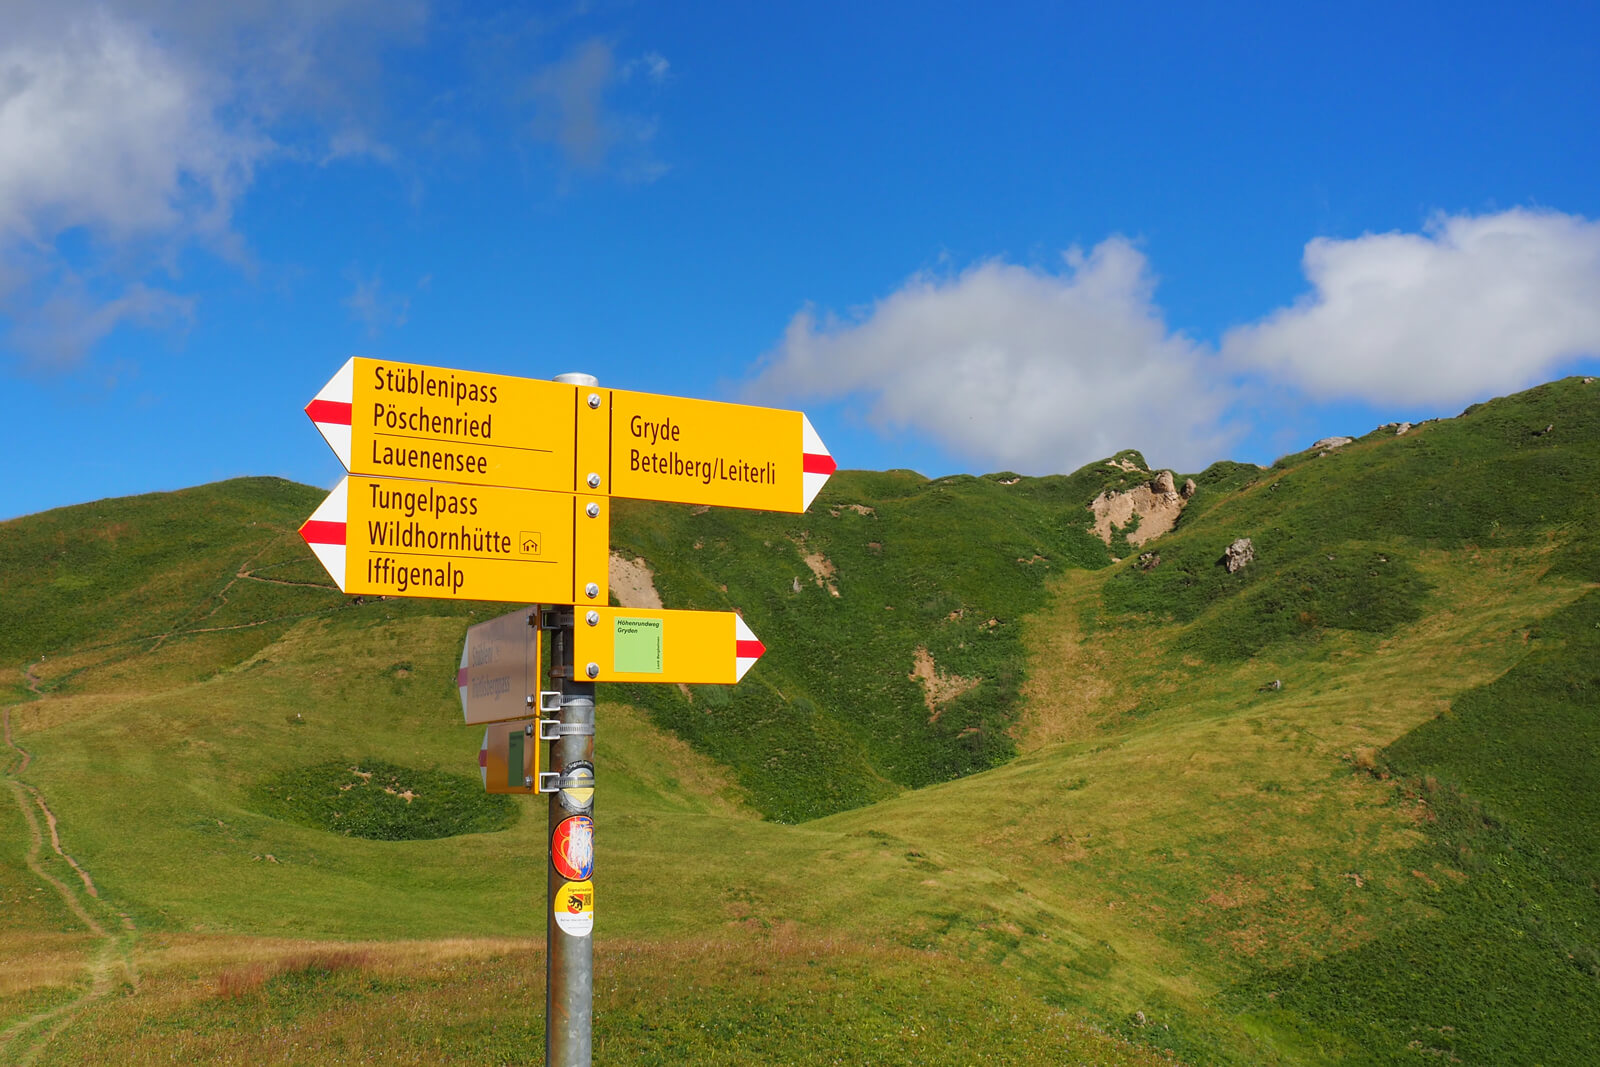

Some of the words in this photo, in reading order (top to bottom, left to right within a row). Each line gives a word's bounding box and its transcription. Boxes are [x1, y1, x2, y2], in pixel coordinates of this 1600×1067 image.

[374, 366, 498, 406] Stüblenipass
[374, 402, 492, 439] Pöschenried
[630, 415, 681, 446] Gryde
[372, 439, 487, 474] Lauenensee
[630, 448, 776, 486] Betelberg/Leiterli
[369, 483, 478, 520] Tungelpass
[368, 520, 511, 555] Wildhornhütte
[368, 558, 464, 596] Iffigenalp
[617, 620, 660, 629] Höhenrundweg
[617, 627, 639, 635] Gryden
